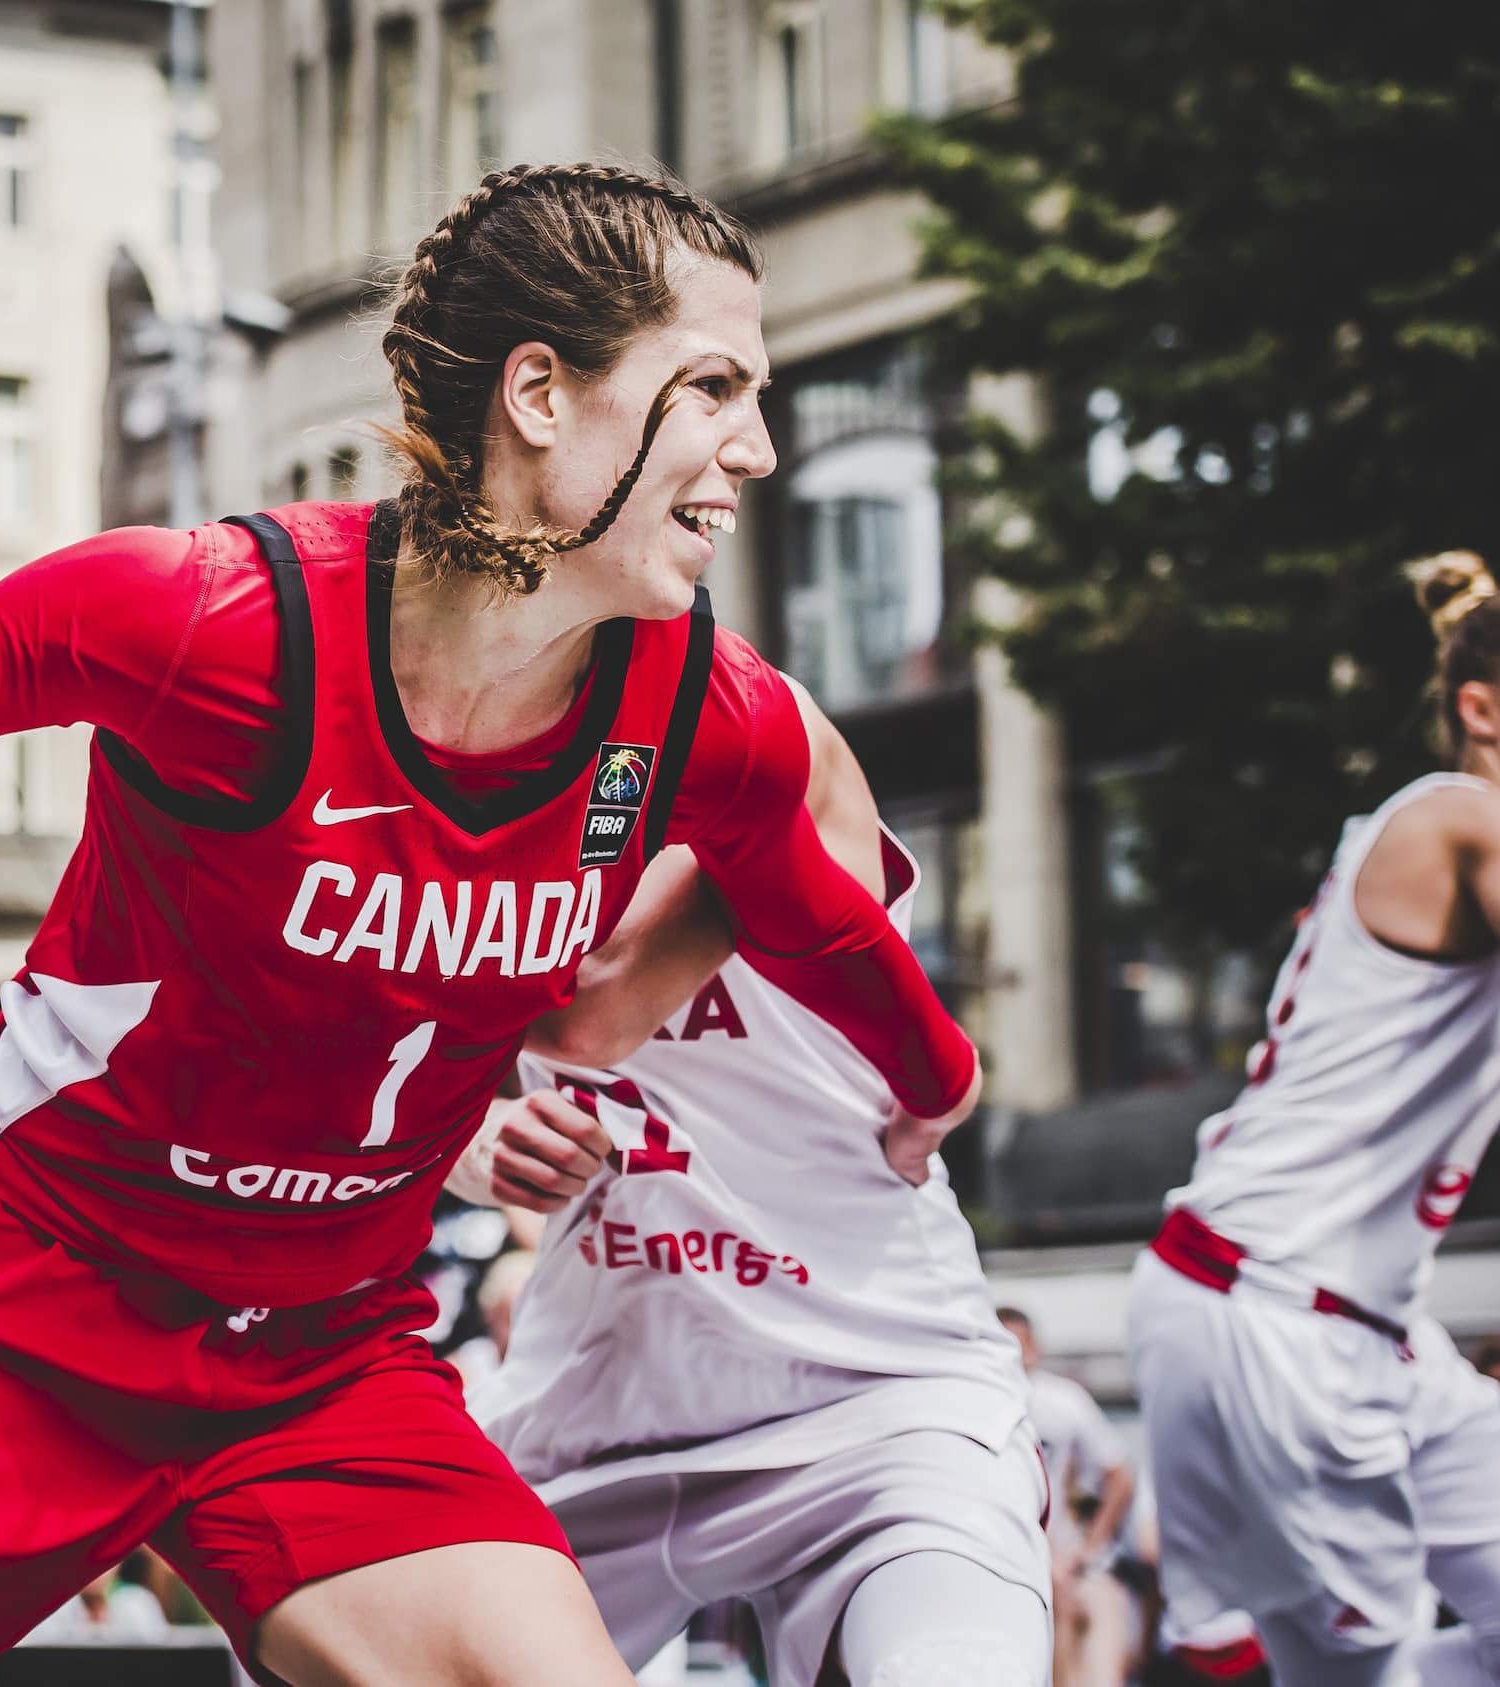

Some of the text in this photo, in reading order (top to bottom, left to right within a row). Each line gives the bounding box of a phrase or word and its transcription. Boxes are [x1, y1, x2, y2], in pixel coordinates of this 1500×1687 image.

[588, 815, 626, 835] FIBA
[282, 860, 602, 978] CANADA
[358, 1020, 437, 1148] 1
